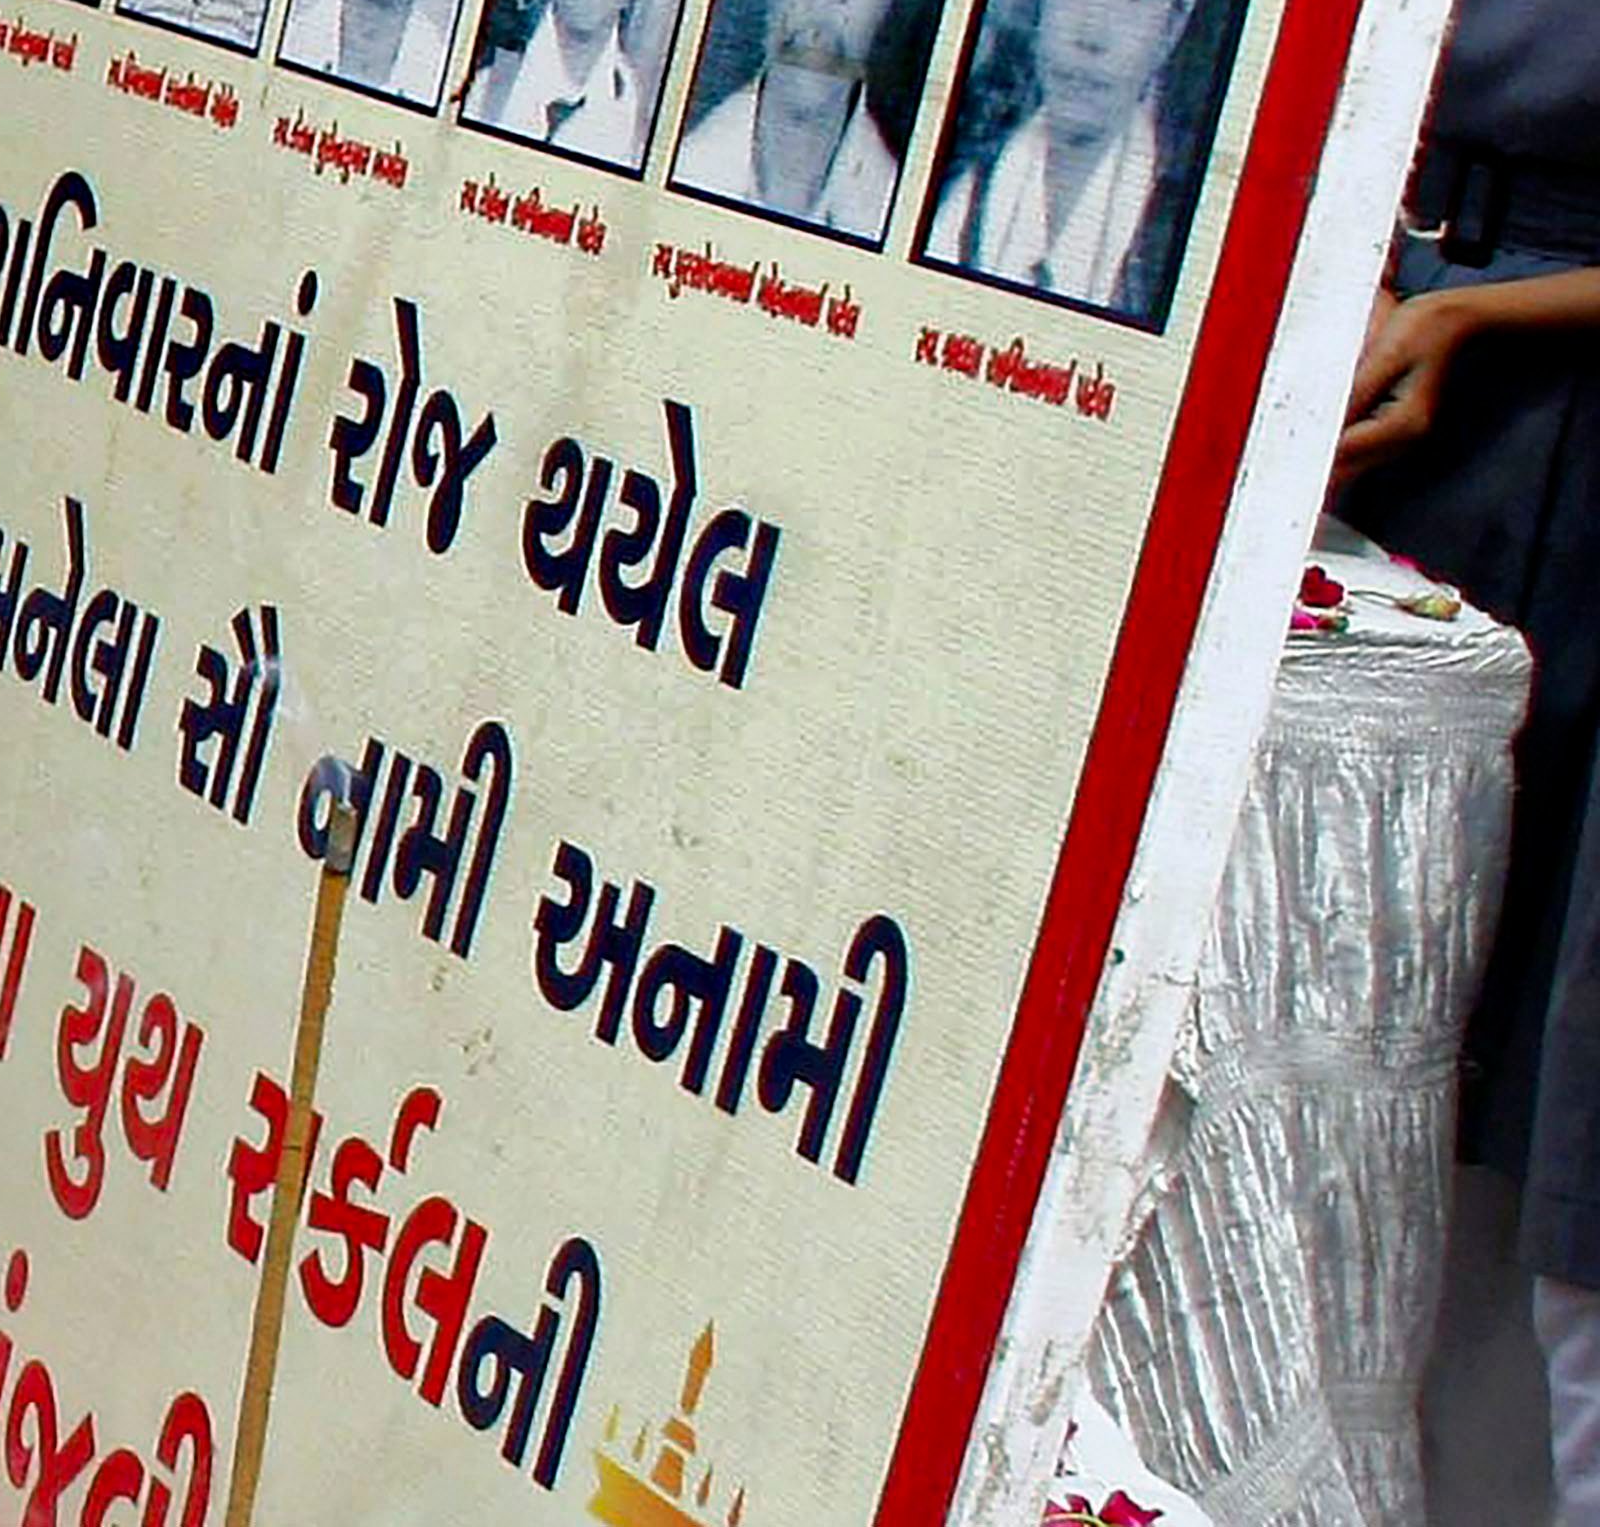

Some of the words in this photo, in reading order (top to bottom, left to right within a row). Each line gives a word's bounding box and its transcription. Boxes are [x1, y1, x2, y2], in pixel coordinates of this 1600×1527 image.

[329, 295, 499, 555] રોજ
[522, 398, 784, 690] થયેલ
[45, 946, 204, 1221] યુથ
[176, 603, 282, 826] સૌ
[297, 718, 516, 960] નામી
[533, 839, 910, 1188] અનામી
